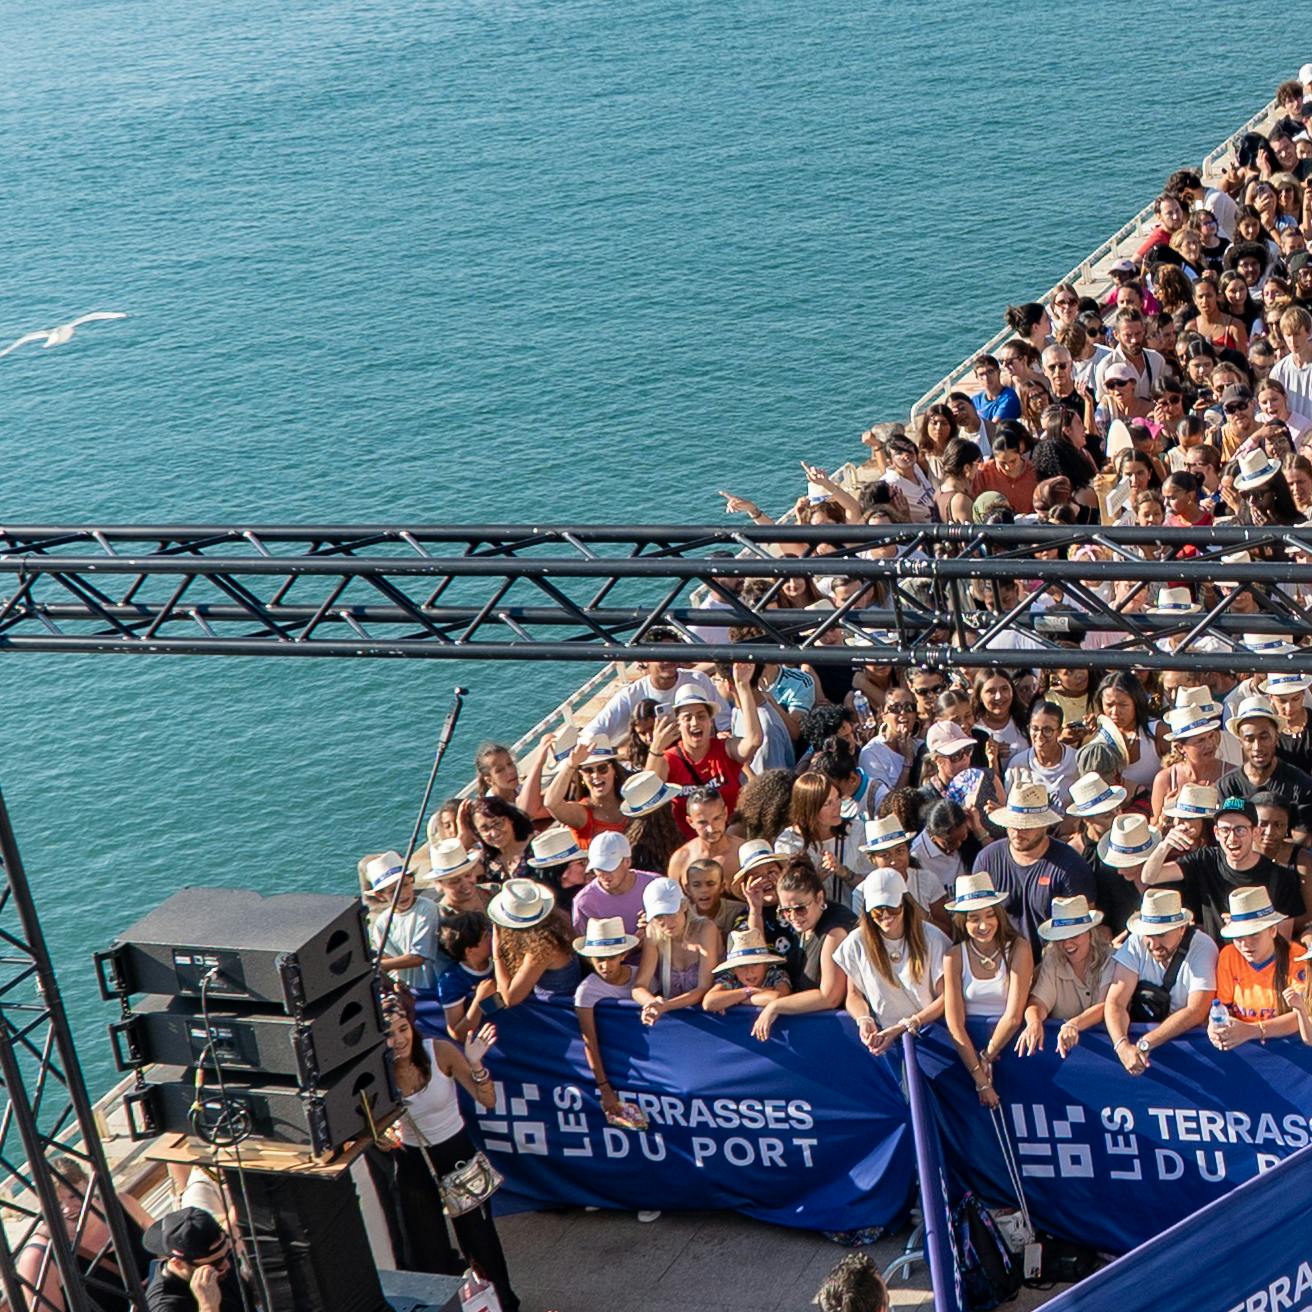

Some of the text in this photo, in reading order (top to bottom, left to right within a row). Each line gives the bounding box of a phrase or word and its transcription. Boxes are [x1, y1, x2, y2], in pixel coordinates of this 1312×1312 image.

[553, 1085, 593, 1157] LES
[594, 1088, 815, 1130] RRASSES
[603, 1127, 818, 1168] DU PORT
[1101, 1106, 1143, 1181] LES
[1154, 1148, 1227, 1183] DU
